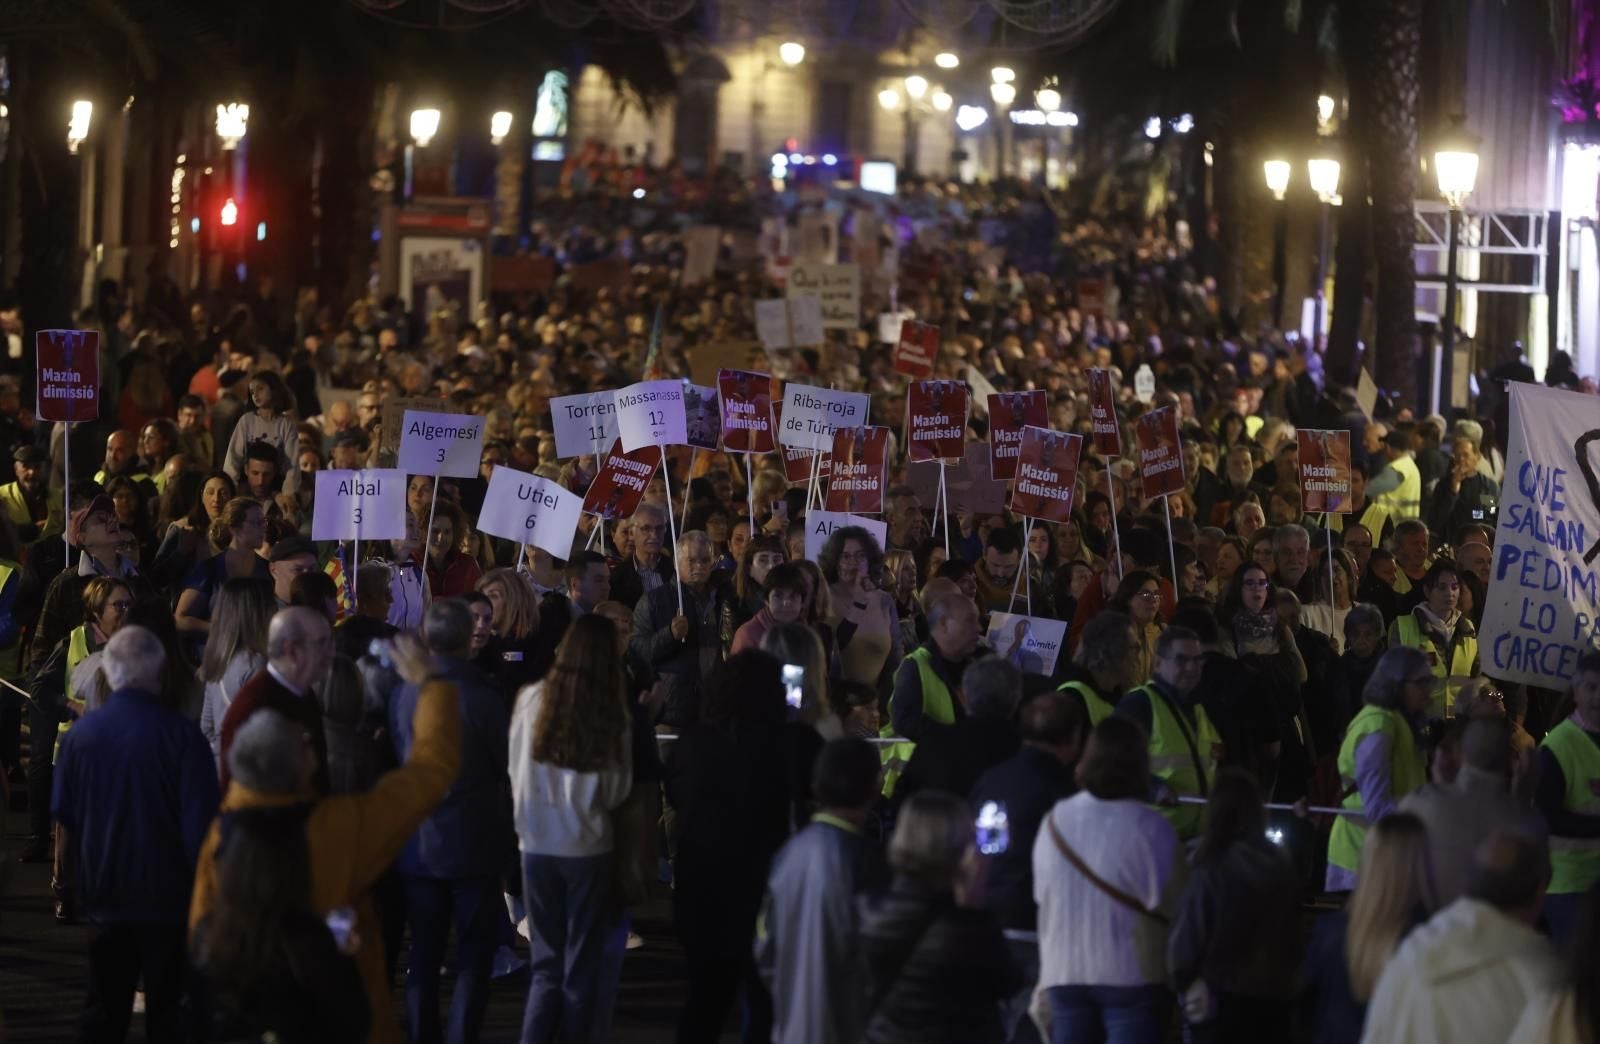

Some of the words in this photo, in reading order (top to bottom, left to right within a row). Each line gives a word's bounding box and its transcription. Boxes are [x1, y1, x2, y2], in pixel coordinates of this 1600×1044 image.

[43, 367, 81, 383] Mazón
[43, 384, 94, 400] dimissió
[619, 389, 681, 409] Massanassa
[565, 401, 616, 421] Torren
[726, 398, 756, 414] Mazón
[793, 393, 855, 416] Riba-roja
[648, 410, 665, 426] 12
[726, 415, 768, 431] dimissió
[786, 417, 803, 430] de
[913, 414, 949, 428] Mazón
[409, 420, 479, 441] Algemesí
[588, 426, 607, 441] 11
[912, 425, 961, 441] dimissió
[994, 427, 1024, 443] Mazó
[436, 448, 445, 462] 3
[1142, 446, 1168, 462] Mazón
[607, 455, 652, 477] dimissió
[834, 461, 867, 475] Mazón
[1021, 463, 1058, 483] Mazón
[1143, 456, 1180, 477] dimissió
[1302, 463, 1337, 478] Mazón
[338, 479, 381, 496] Albal
[612, 472, 646, 492] Mazón
[831, 475, 879, 491] dimissió
[1018, 479, 1069, 501] dimissió
[1304, 477, 1347, 493] dimissió
[1518, 460, 1566, 511] QUE
[517, 483, 559, 511] Utiel
[354, 508, 363, 524] 3
[525, 514, 536, 530] 6
[1501, 504, 1584, 553] SALGAN
[1519, 597, 1556, 634] LO
[1027, 639, 1057, 651] Dimitir
